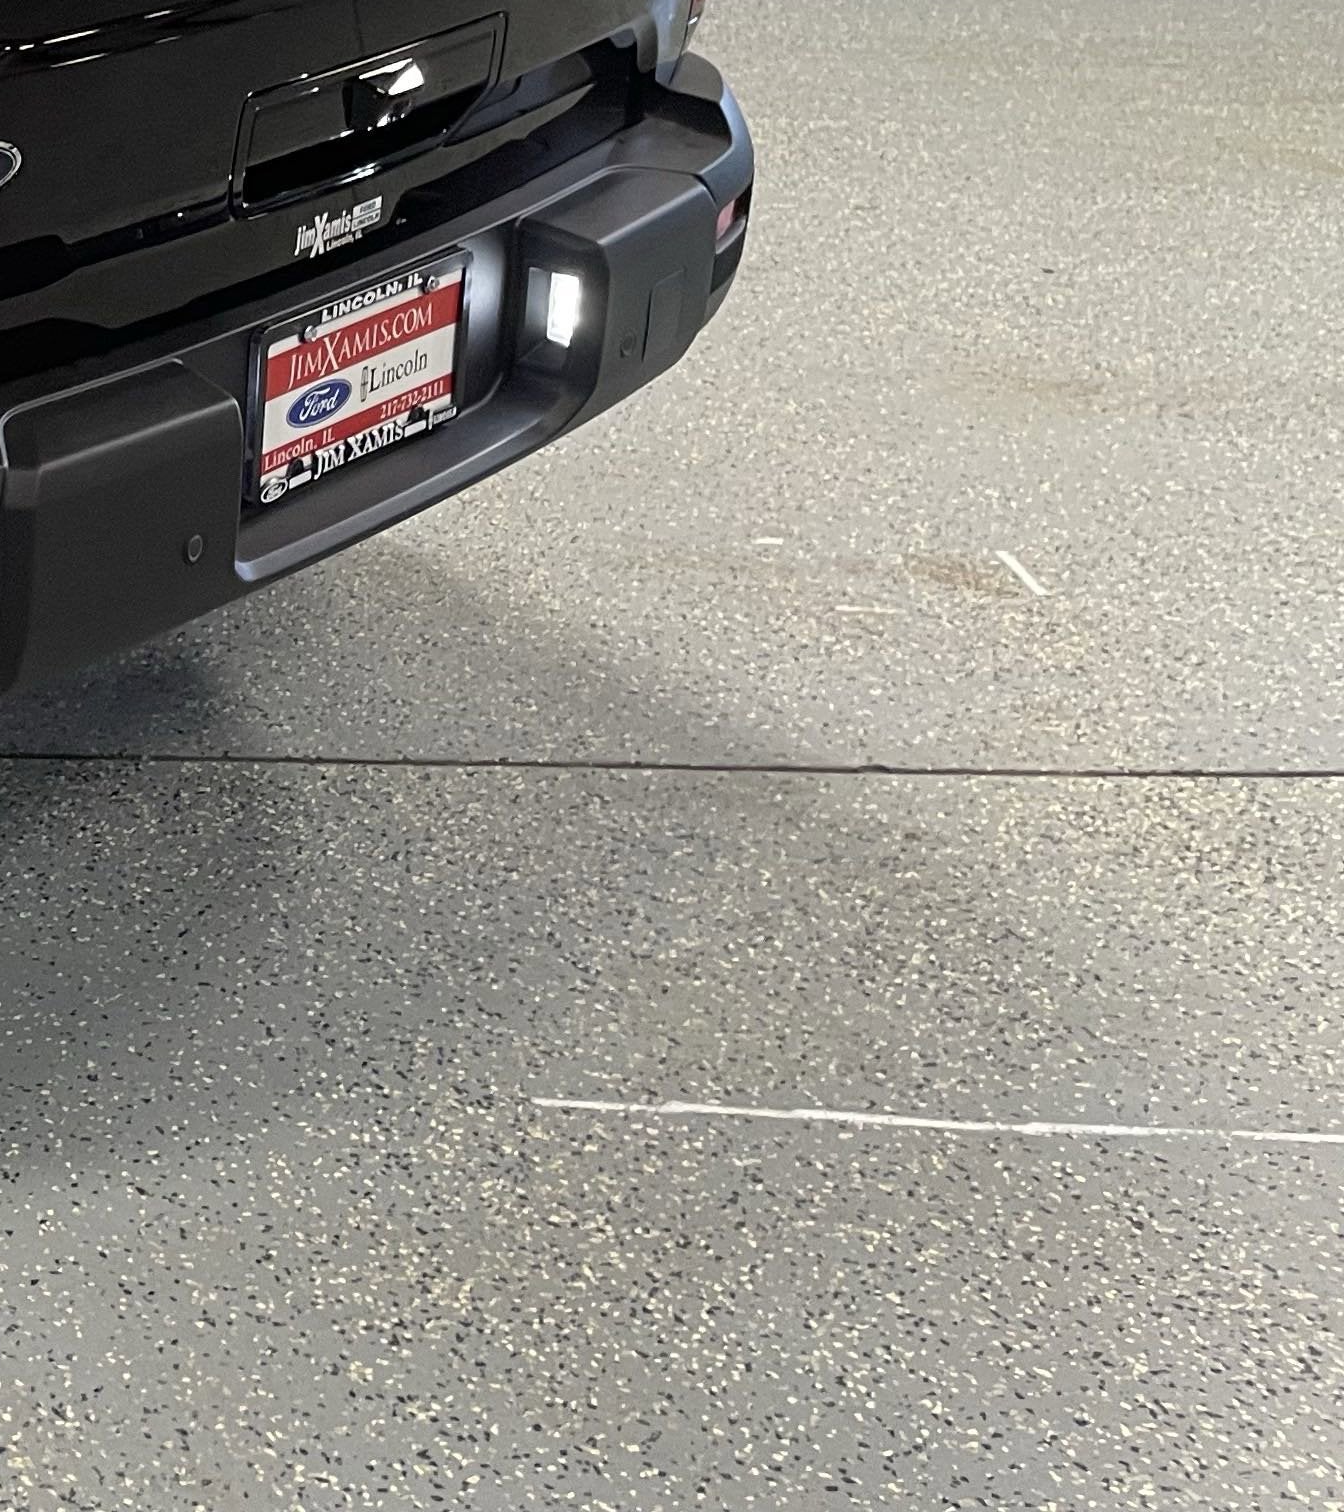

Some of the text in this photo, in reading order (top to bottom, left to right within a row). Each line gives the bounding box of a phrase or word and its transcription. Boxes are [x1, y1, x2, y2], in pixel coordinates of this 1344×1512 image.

[407, 272, 423, 289] IL
[287, 303, 433, 390] JIMXAMIS.COM
[369, 349, 428, 393] Lincoln
[298, 387, 340, 420] Ford
[313, 422, 404, 480] JIM XAMIS
[322, 428, 335, 445] IL
